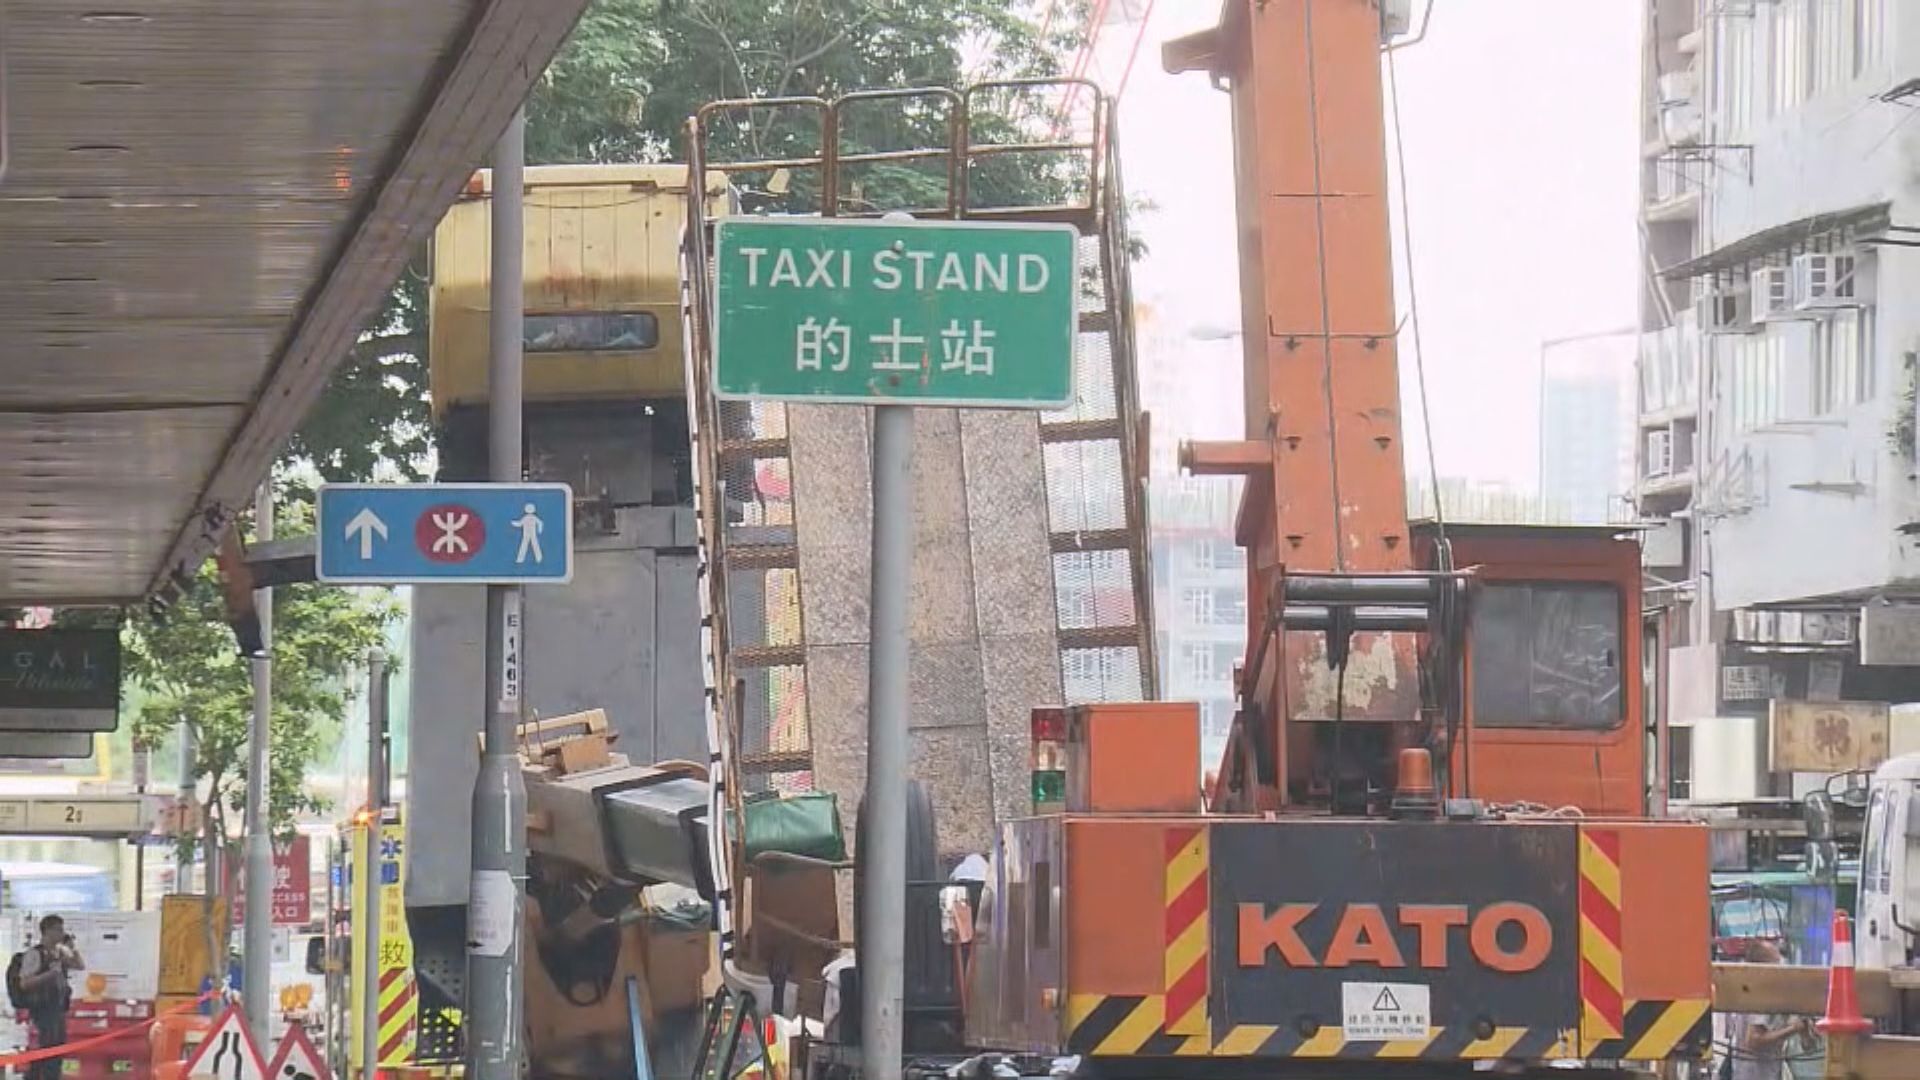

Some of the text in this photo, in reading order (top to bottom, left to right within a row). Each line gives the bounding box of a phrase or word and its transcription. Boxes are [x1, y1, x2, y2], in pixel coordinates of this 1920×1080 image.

[739, 247, 1050, 294] TAXI STAND
[796, 316, 996, 376] 的士站
[1237, 901, 1553, 973] KATO
